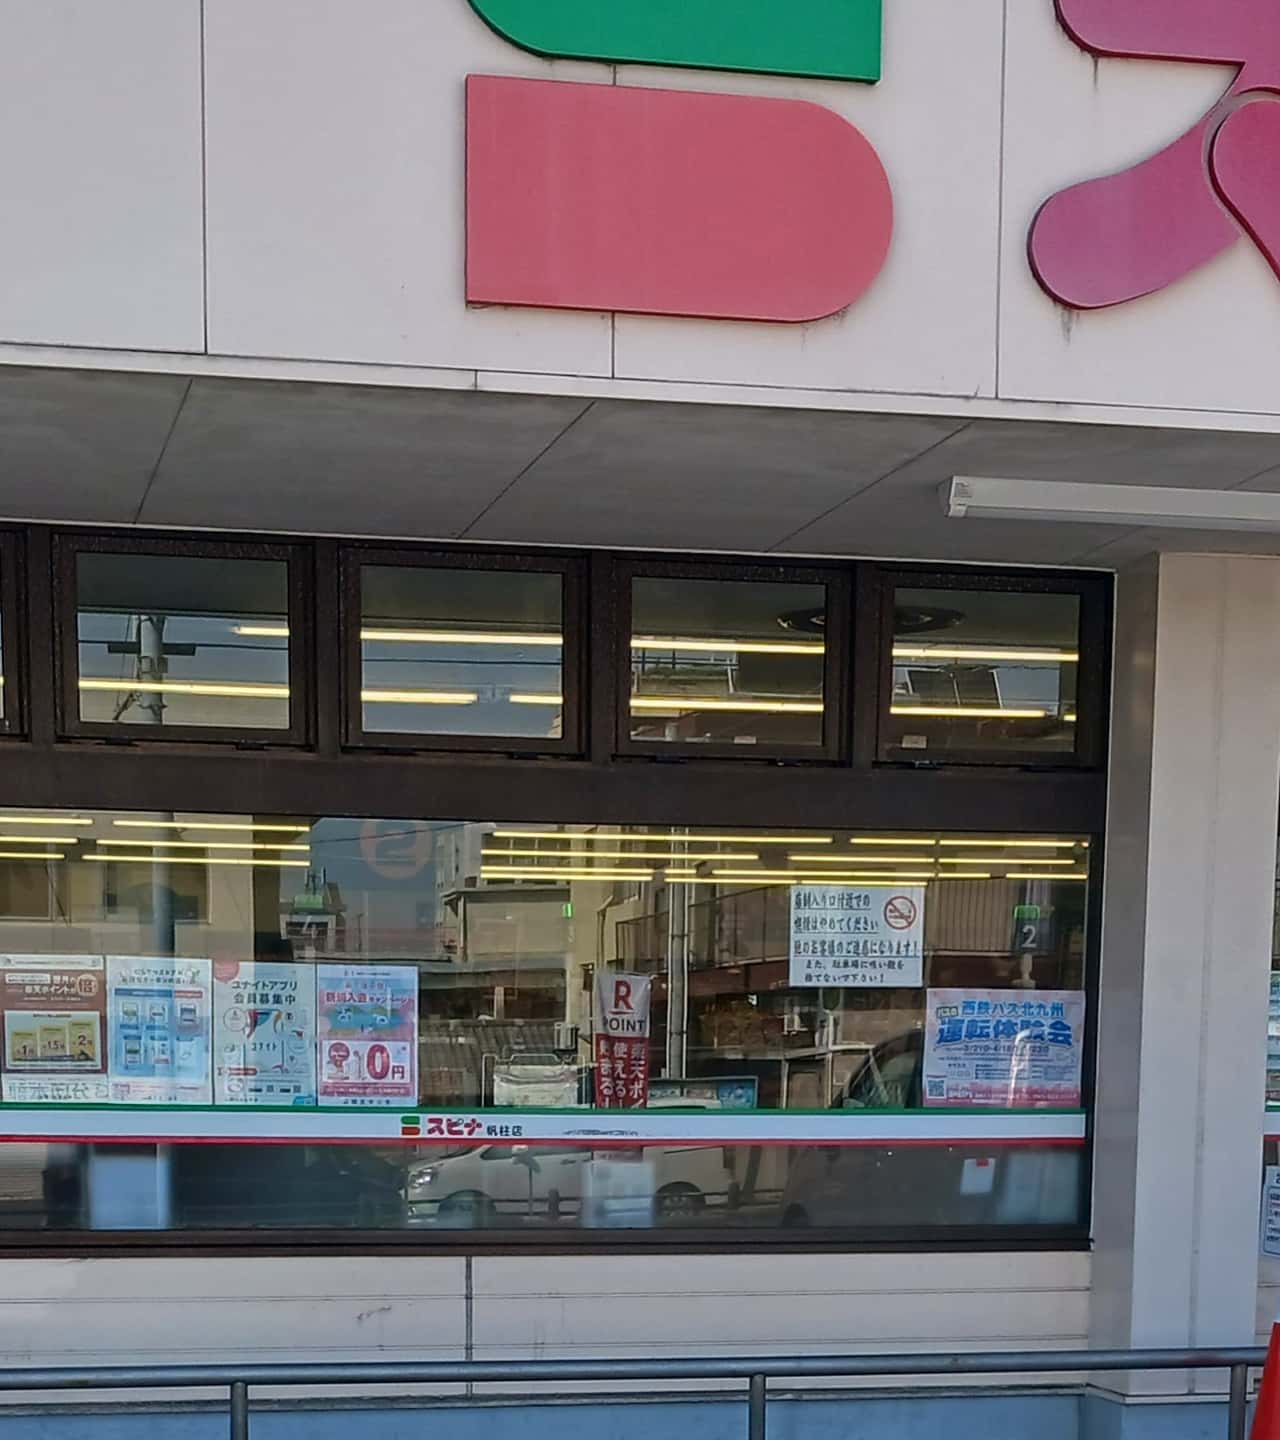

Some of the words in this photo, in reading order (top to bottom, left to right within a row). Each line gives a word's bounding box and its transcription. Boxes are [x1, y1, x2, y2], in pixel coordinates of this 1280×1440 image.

[1021, 924, 1038, 948] 2
[614, 980, 633, 1011] R
[936, 1018, 1073, 1046] 運転体験会
[426, 1118, 483, 1136] スピナ
